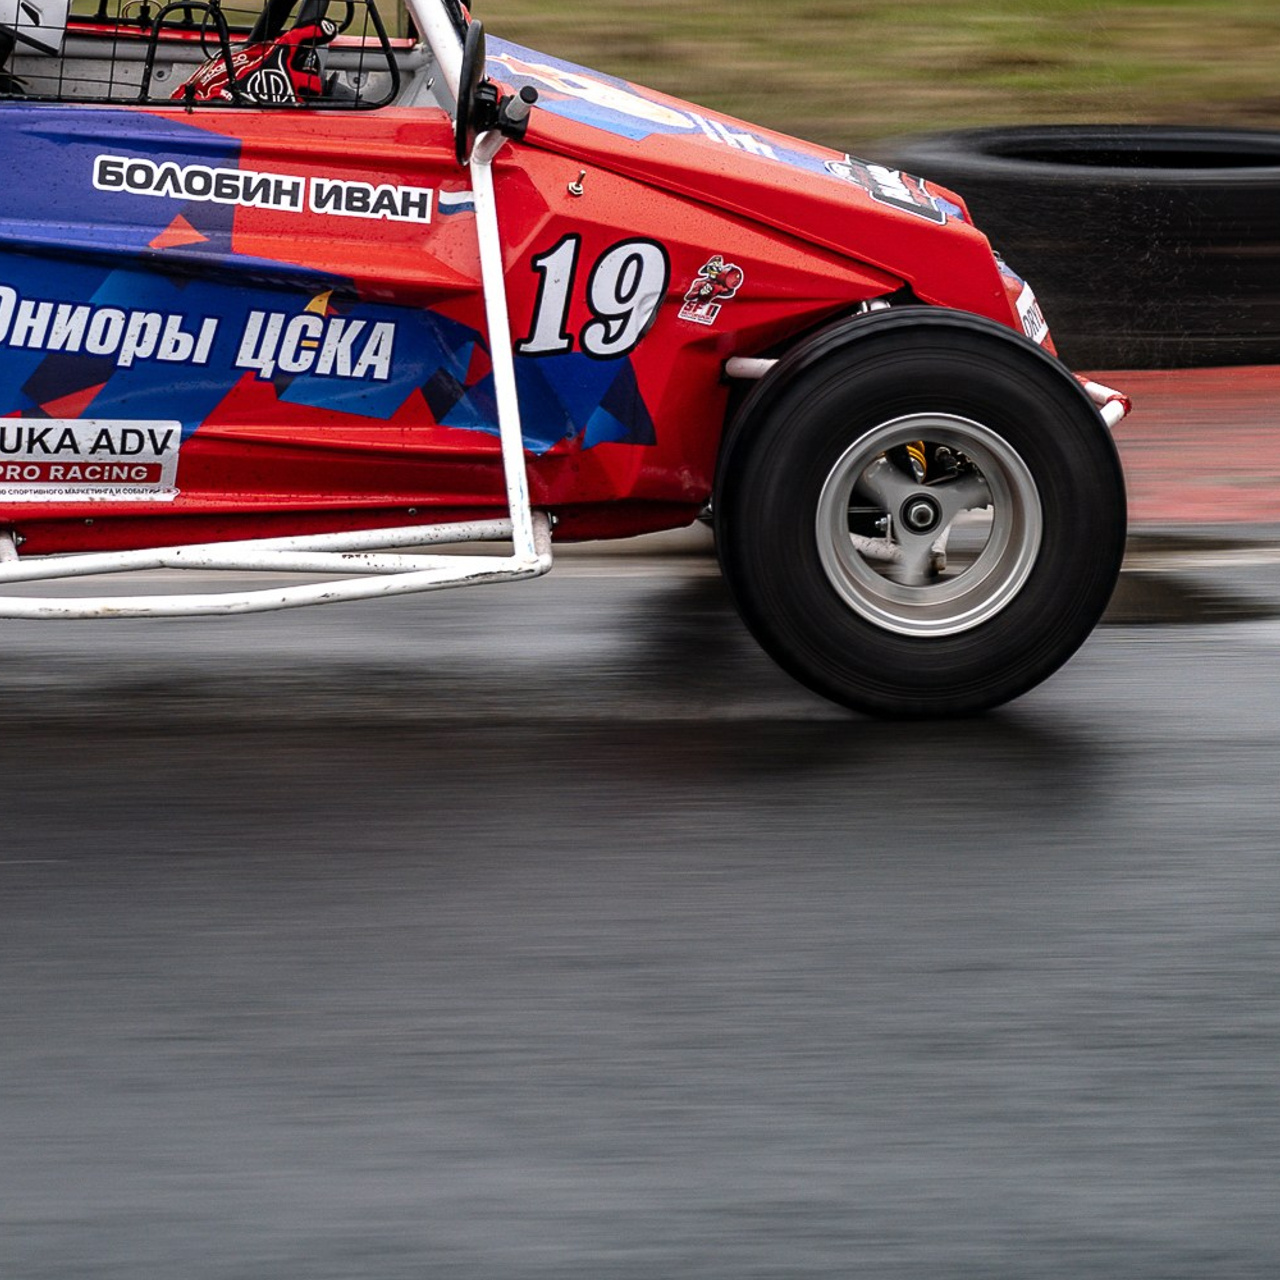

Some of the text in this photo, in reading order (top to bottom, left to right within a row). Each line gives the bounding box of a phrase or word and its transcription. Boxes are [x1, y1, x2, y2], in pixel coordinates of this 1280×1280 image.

[97, 159, 428, 218] БОЛОБИН ИВАН
[518, 235, 669, 357] 19
[235, 310, 397, 380] ЦСКА
[88, 428, 174, 456] ADV
[48, 465, 148, 480] RACING
